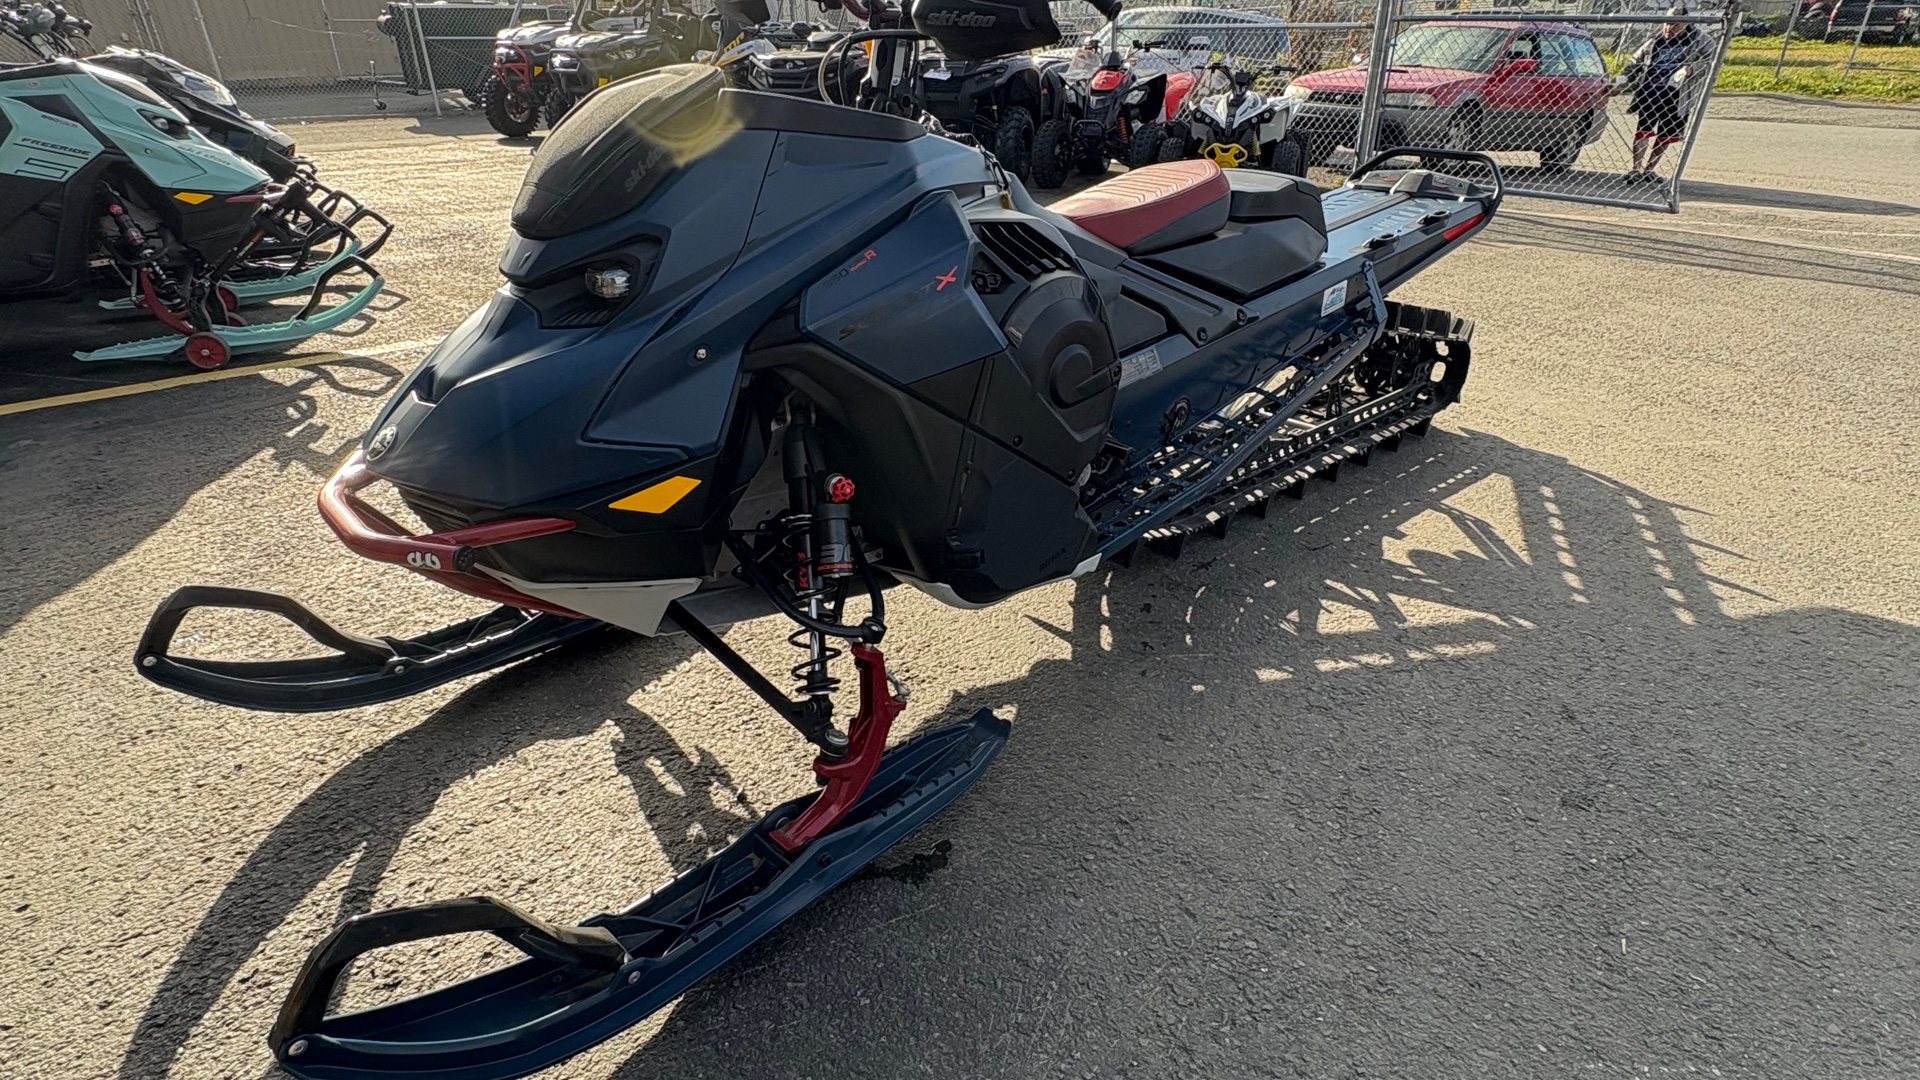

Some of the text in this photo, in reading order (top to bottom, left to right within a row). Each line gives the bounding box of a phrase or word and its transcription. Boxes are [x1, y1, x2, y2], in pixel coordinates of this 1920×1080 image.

[926, 10, 997, 28] ski-doo
[21, 137, 91, 156] FREERIDE
[935, 265, 958, 291] X
